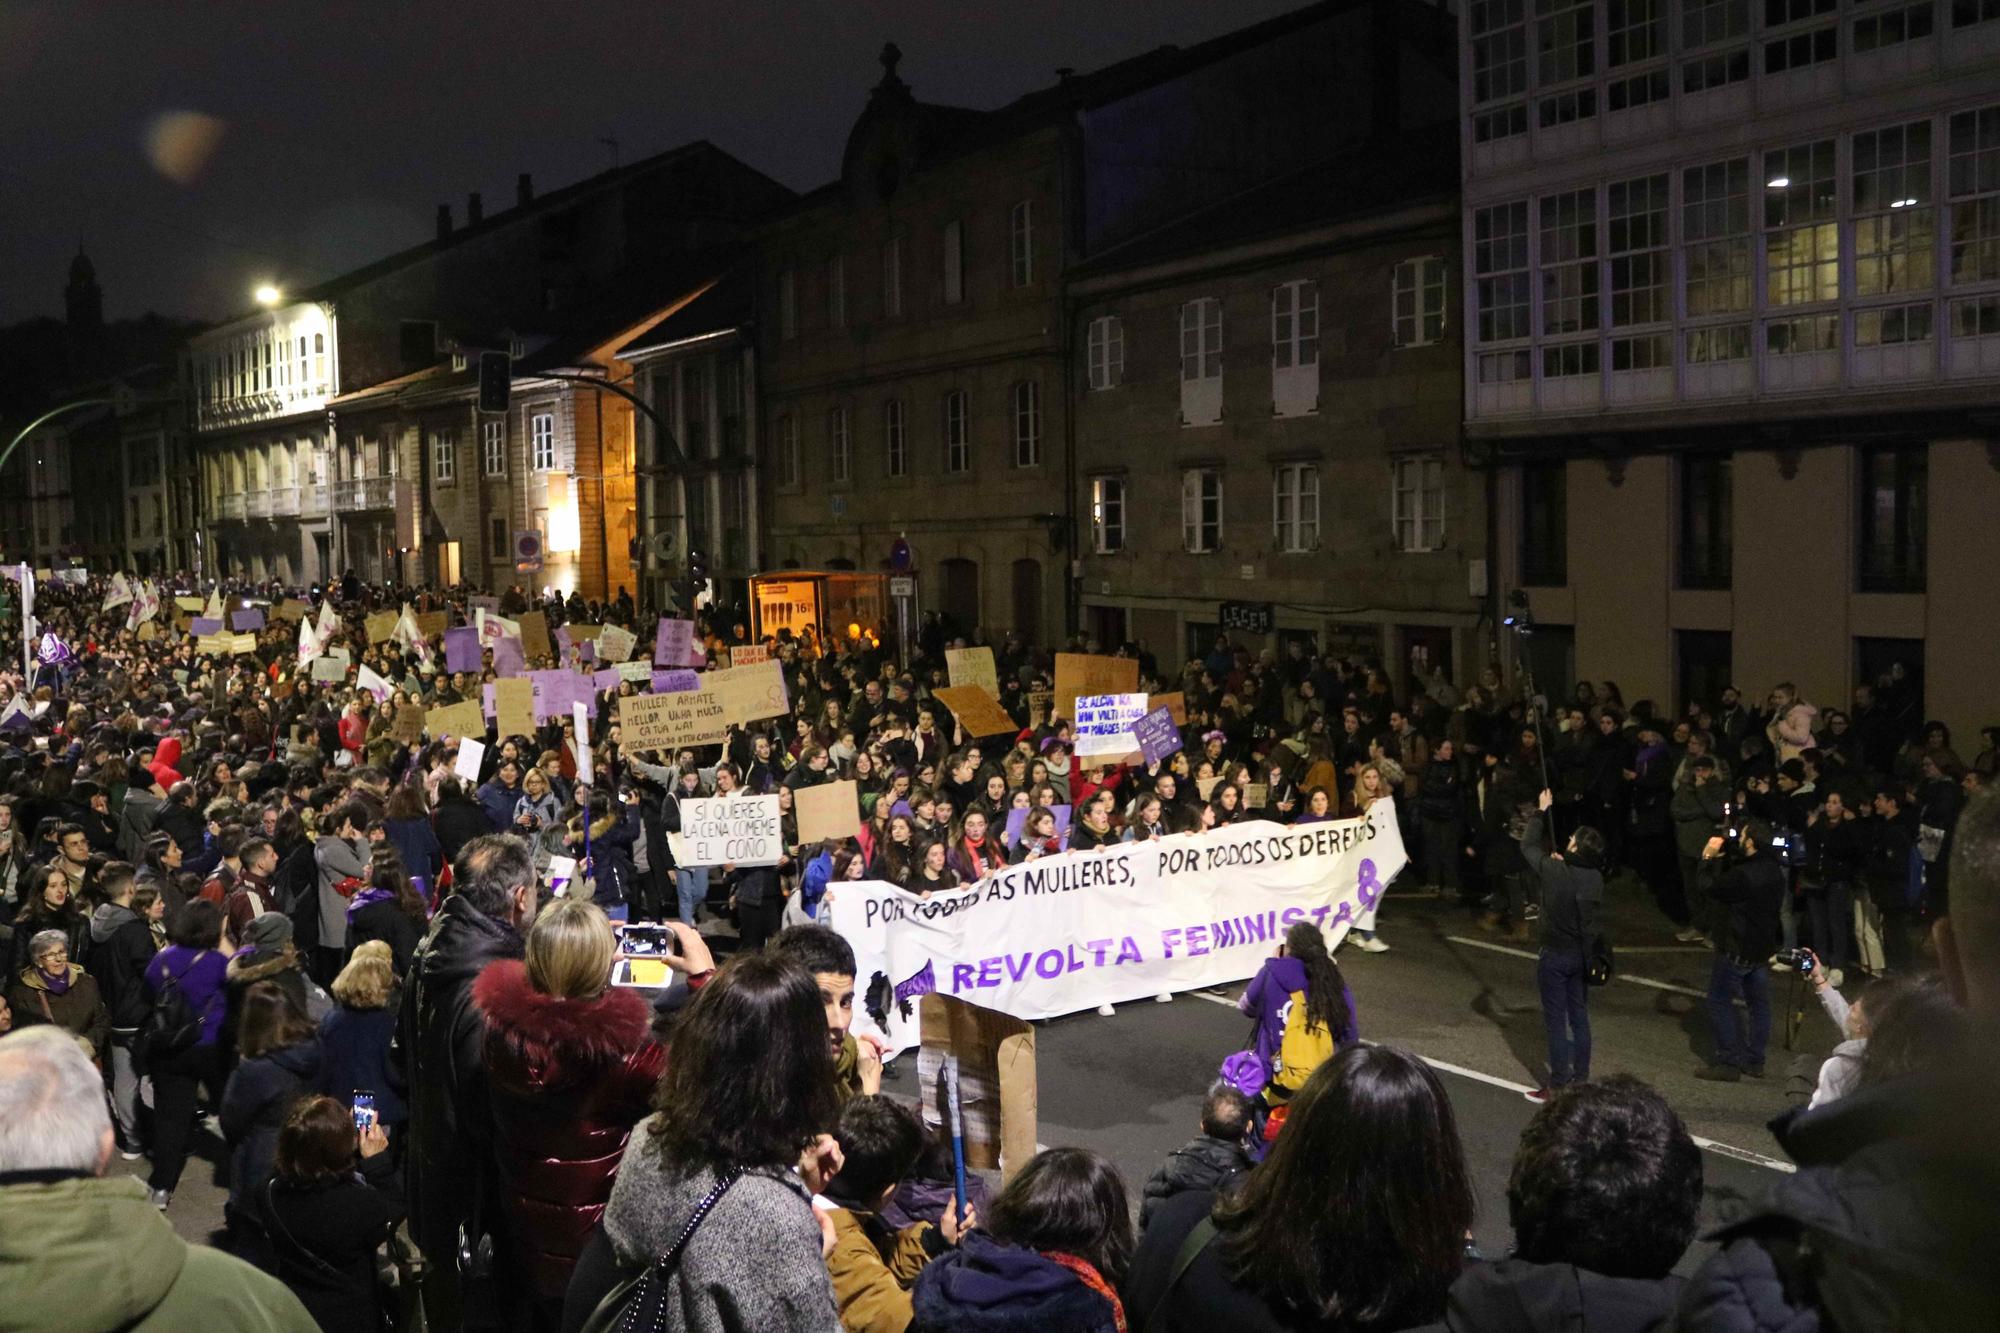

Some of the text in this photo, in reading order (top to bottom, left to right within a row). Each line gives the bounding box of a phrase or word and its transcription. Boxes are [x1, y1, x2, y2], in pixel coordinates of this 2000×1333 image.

[632, 696, 668, 712] MULLER
[627, 712, 661, 727] MELLOR
[696, 705, 724, 718] MULTA
[713, 799, 765, 820] QUIERES
[683, 822, 698, 839] LA
[701, 821, 729, 838] CENA
[696, 837, 766, 860] EL COÑO
[986, 875, 1016, 902] AS
[1024, 856, 1136, 895] MULLERES,
[1158, 848, 1198, 877] POR
[1206, 839, 1265, 870] TODOS
[1268, 835, 1294, 861] OS
[952, 936, 1143, 994] REVOLTA
[1160, 901, 1355, 959] FEMINISTA
